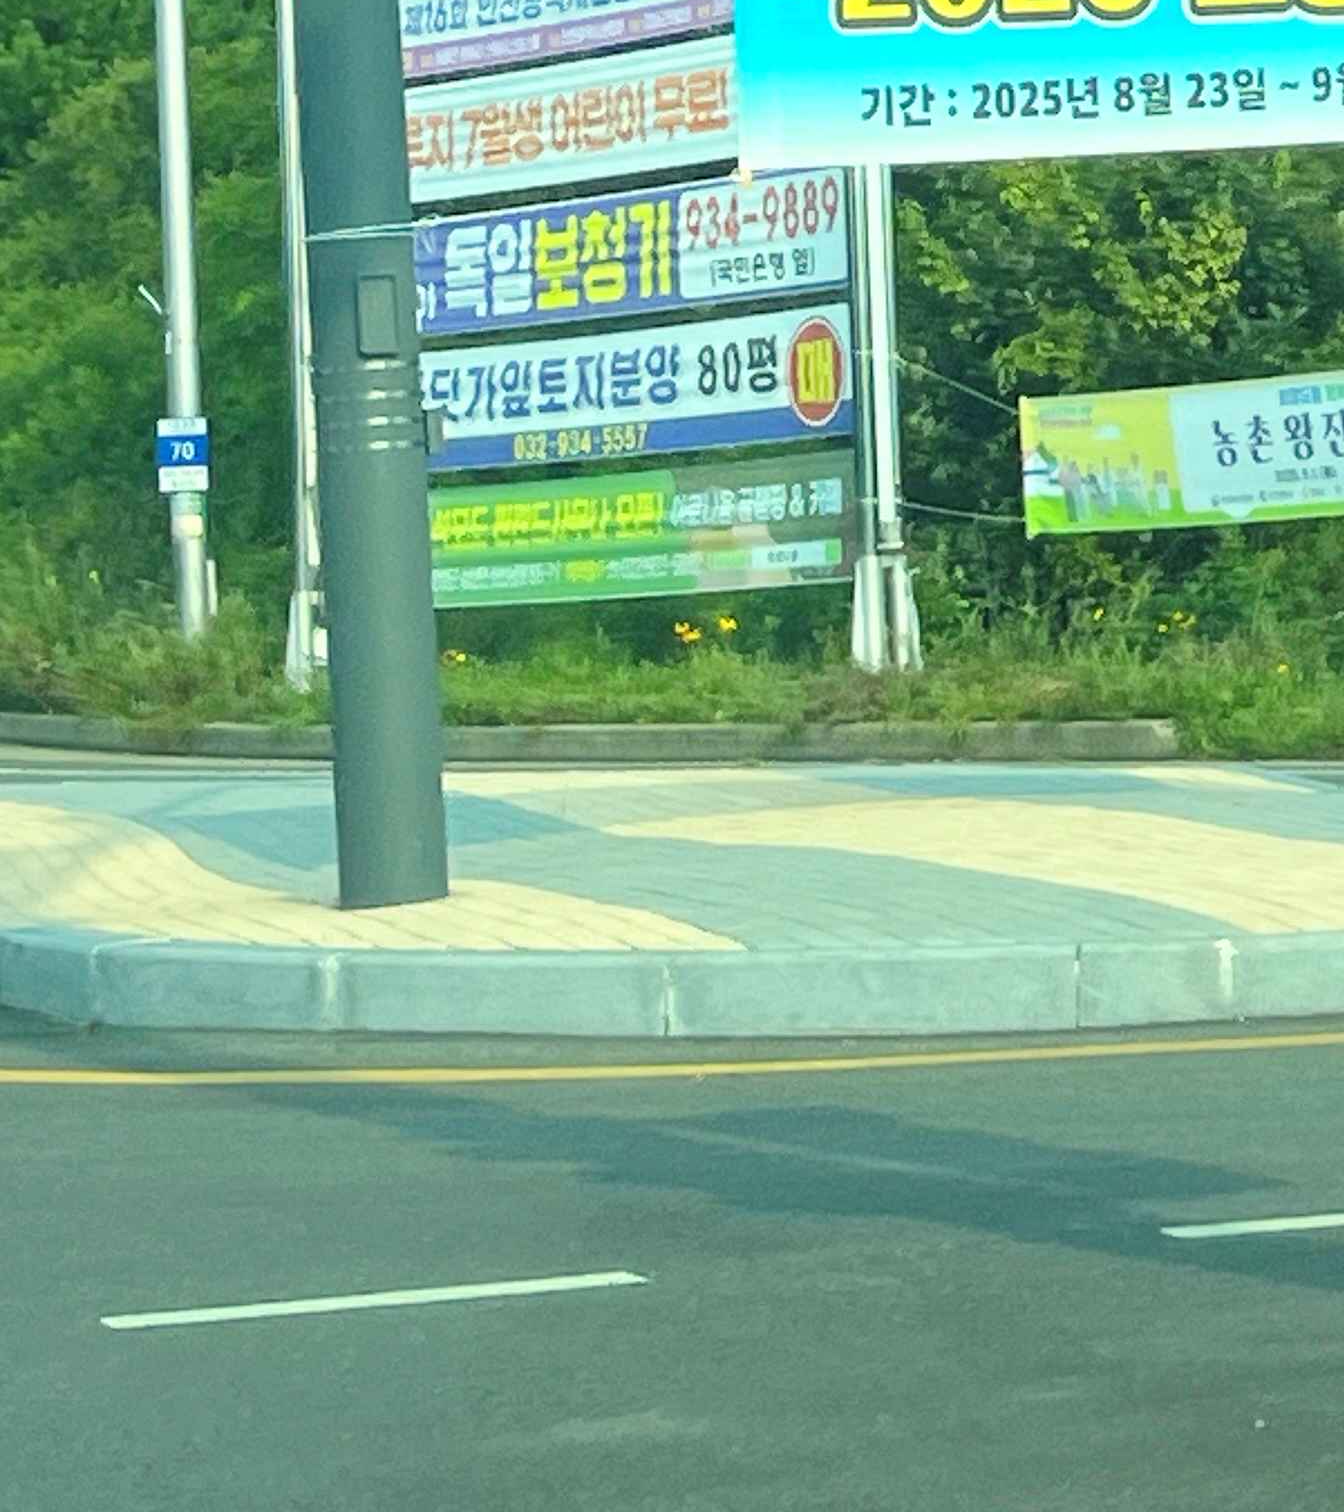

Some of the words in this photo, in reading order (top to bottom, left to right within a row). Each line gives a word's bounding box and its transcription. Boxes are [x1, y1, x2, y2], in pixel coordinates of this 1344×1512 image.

[550, 79, 647, 152] 어린이
[860, 84, 935, 128] 기간
[972, 76, 1101, 120] 2025년
[1113, 70, 1174, 117] 8월
[1186, 66, 1267, 112] 23일
[686, 176, 839, 251] 934-9889
[697, 333, 779, 397] 80평
[169, 440, 196, 462] 70
